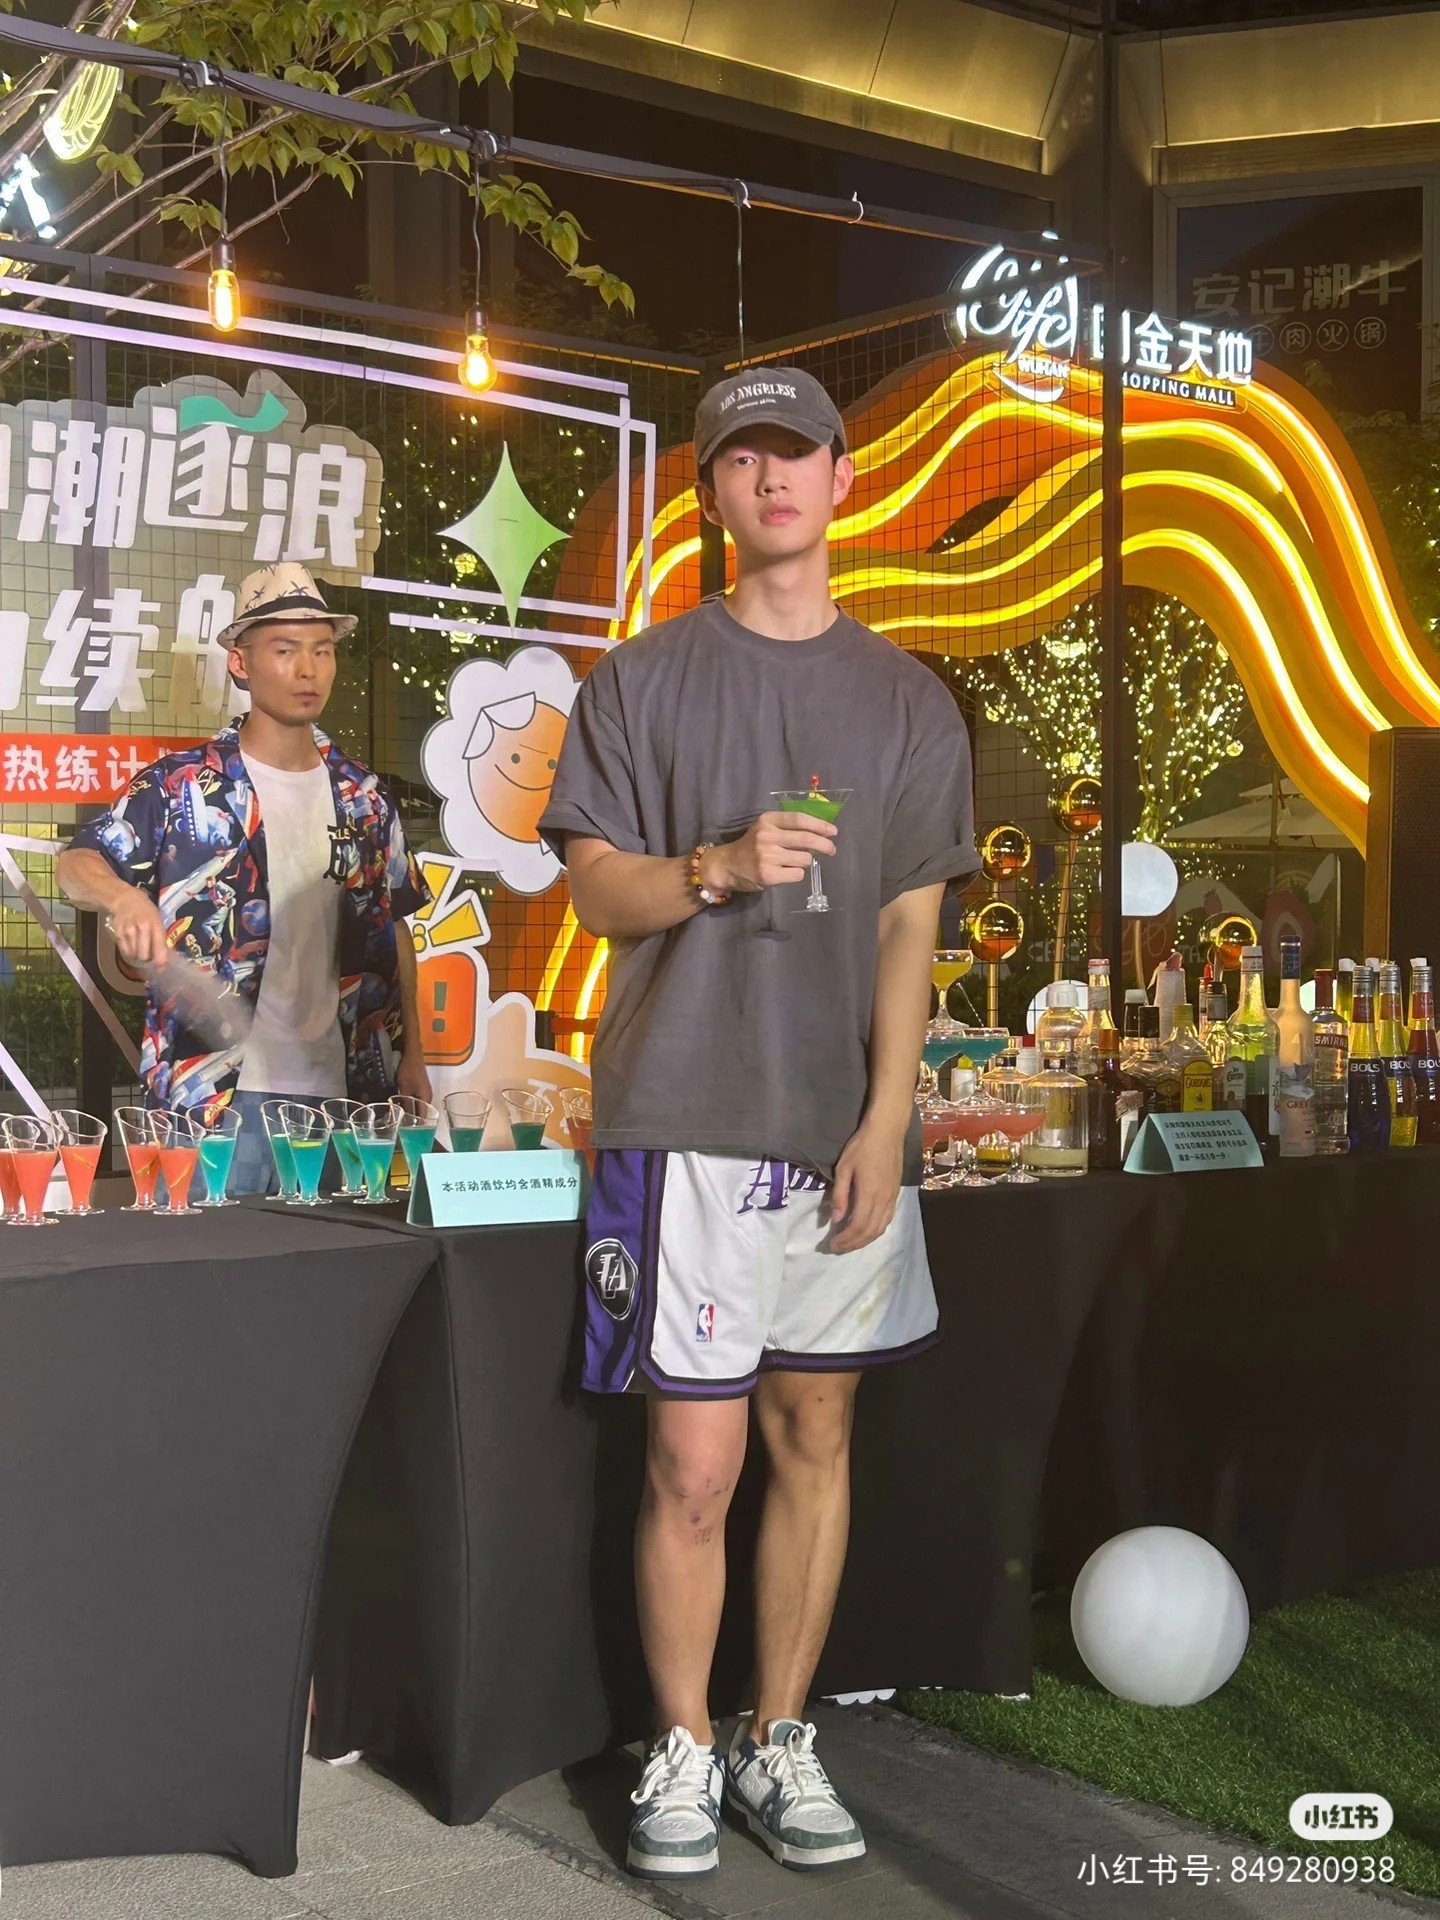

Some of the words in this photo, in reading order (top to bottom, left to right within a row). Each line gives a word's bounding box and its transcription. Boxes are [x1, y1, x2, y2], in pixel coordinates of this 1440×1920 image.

[1192, 260, 1406, 318] 安记潮牛
[1122, 370, 1190, 399] HOPPING
[1195, 386, 1234, 407] MALL
[0, 390, 367, 568] 潮逐浪
[3, 743, 172, 795] 热练计
[1349, 1062, 1381, 1073] BOLS
[441, 1176, 578, 1192] 本活动酒饮均含酒精成分
